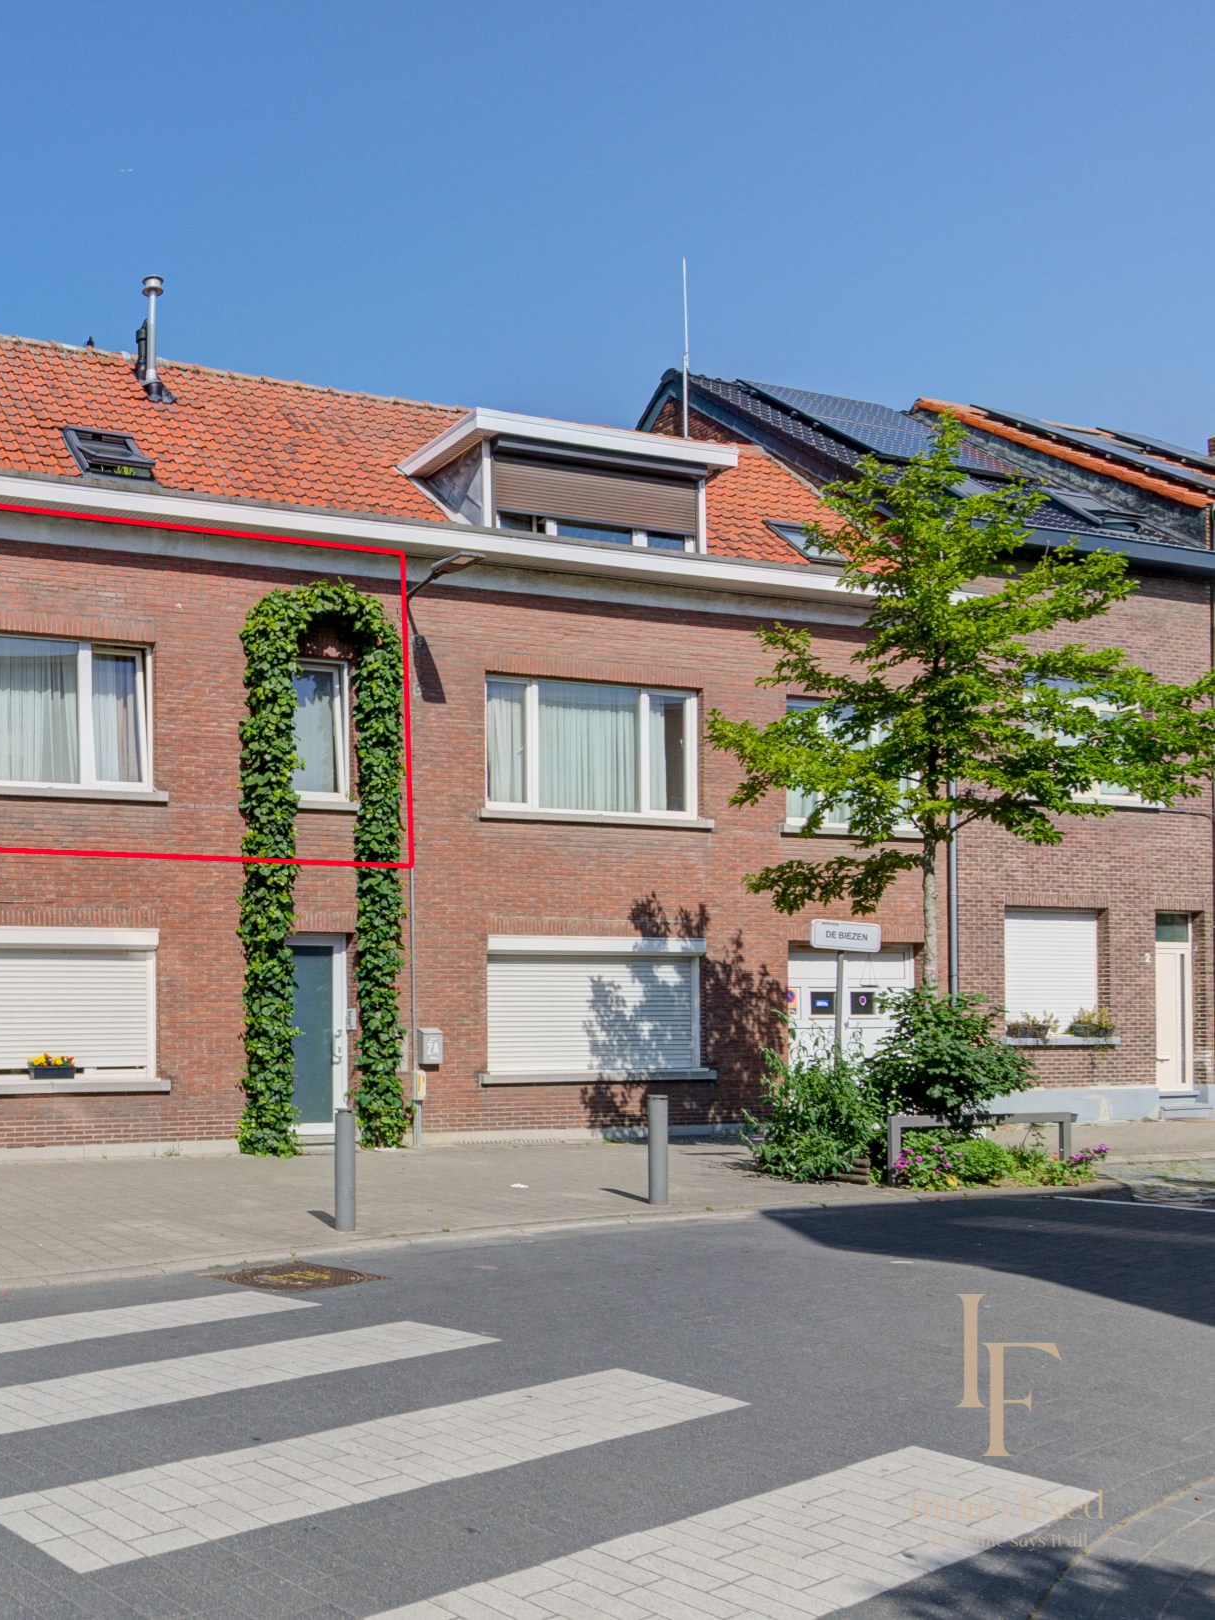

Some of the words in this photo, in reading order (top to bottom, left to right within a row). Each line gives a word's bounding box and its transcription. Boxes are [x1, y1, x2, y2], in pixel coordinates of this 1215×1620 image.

[825, 931, 837, 939] DE
[838, 931, 868, 941] BIEZEN
[1144, 953, 1152, 963] 2
[427, 1042, 439, 1055] 2A
